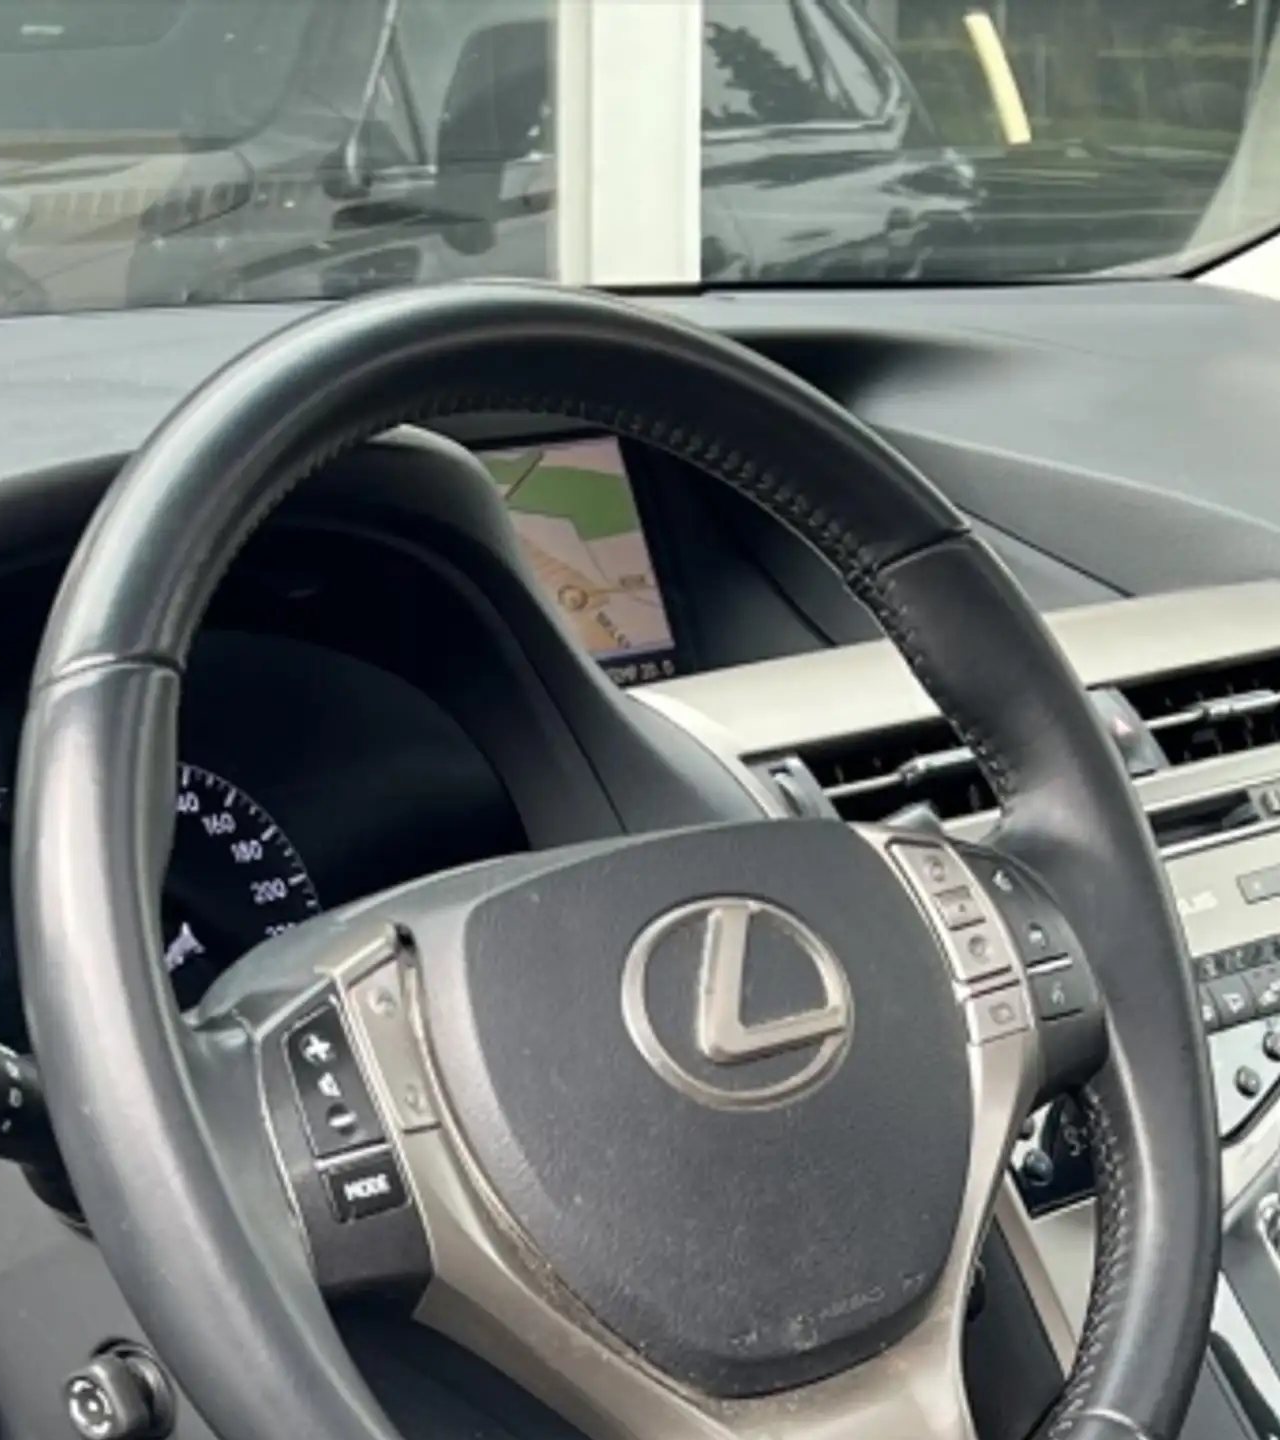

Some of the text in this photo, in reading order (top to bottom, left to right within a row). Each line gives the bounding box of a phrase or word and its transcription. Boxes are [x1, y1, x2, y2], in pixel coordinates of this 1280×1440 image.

[176, 790, 200, 813] 40
[201, 811, 237, 837] 160
[230, 839, 263, 864] 180
[250, 877, 289, 905] 200
[343, 1172, 392, 1202] MODE
